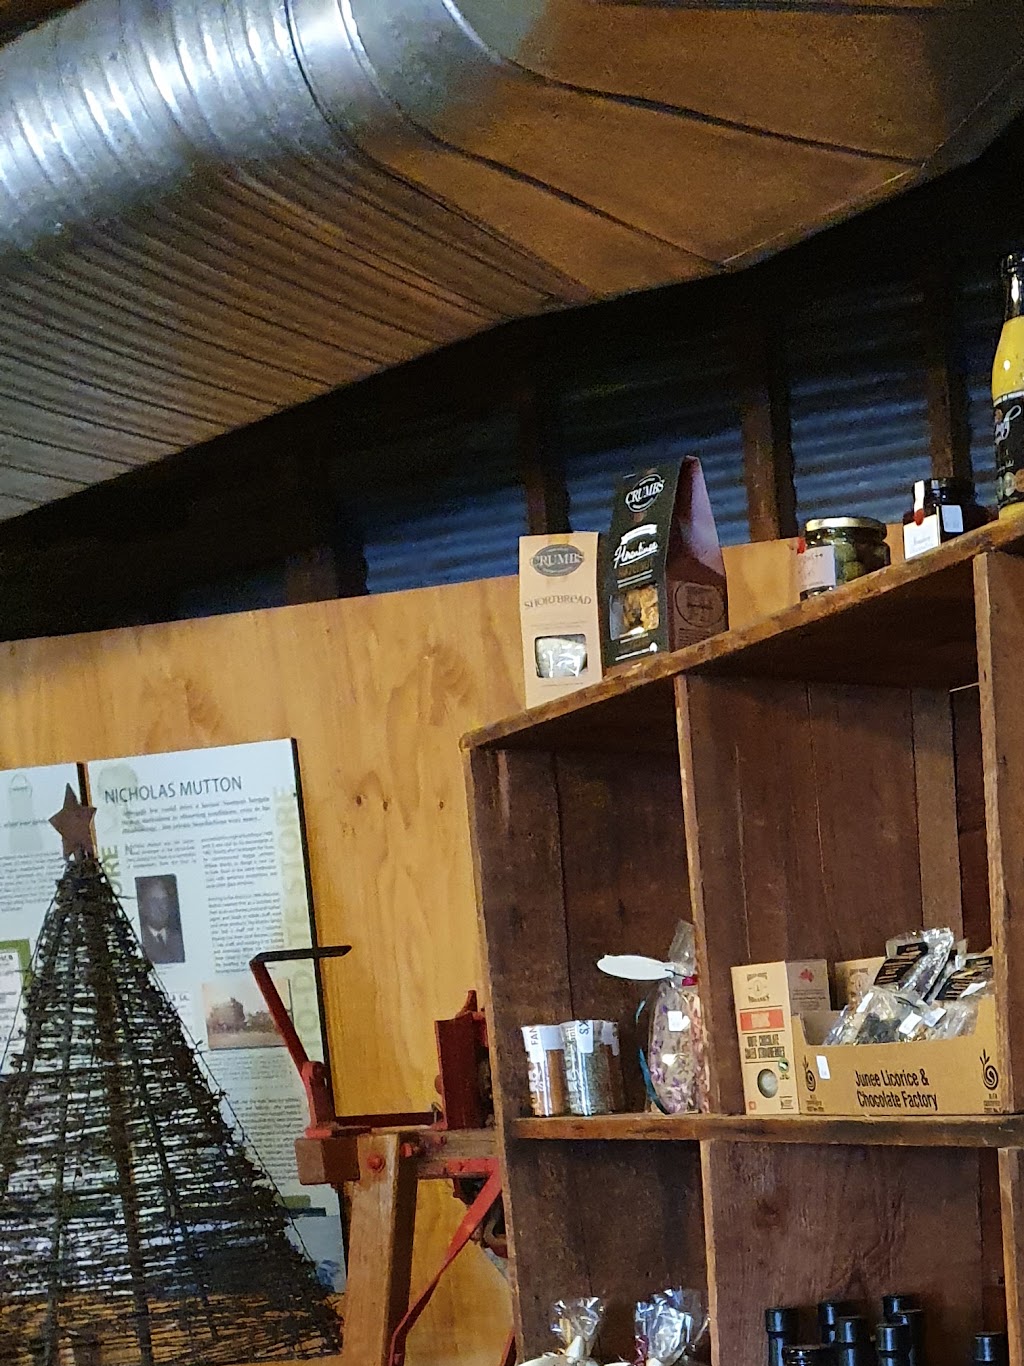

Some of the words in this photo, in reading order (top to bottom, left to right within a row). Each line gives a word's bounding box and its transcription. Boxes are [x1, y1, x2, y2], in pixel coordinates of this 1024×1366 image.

[624, 478, 665, 506] CRUMBS
[530, 552, 585, 568] CRUMBS
[104, 782, 176, 804] NICHOLAS
[179, 775, 242, 797] MUTTON
[855, 1070, 880, 1087] Junee
[881, 1068, 918, 1086] Licorice
[920, 1067, 930, 1086] &
[856, 1091, 899, 1109] Chocolate
[900, 1090, 938, 1111] Factory
